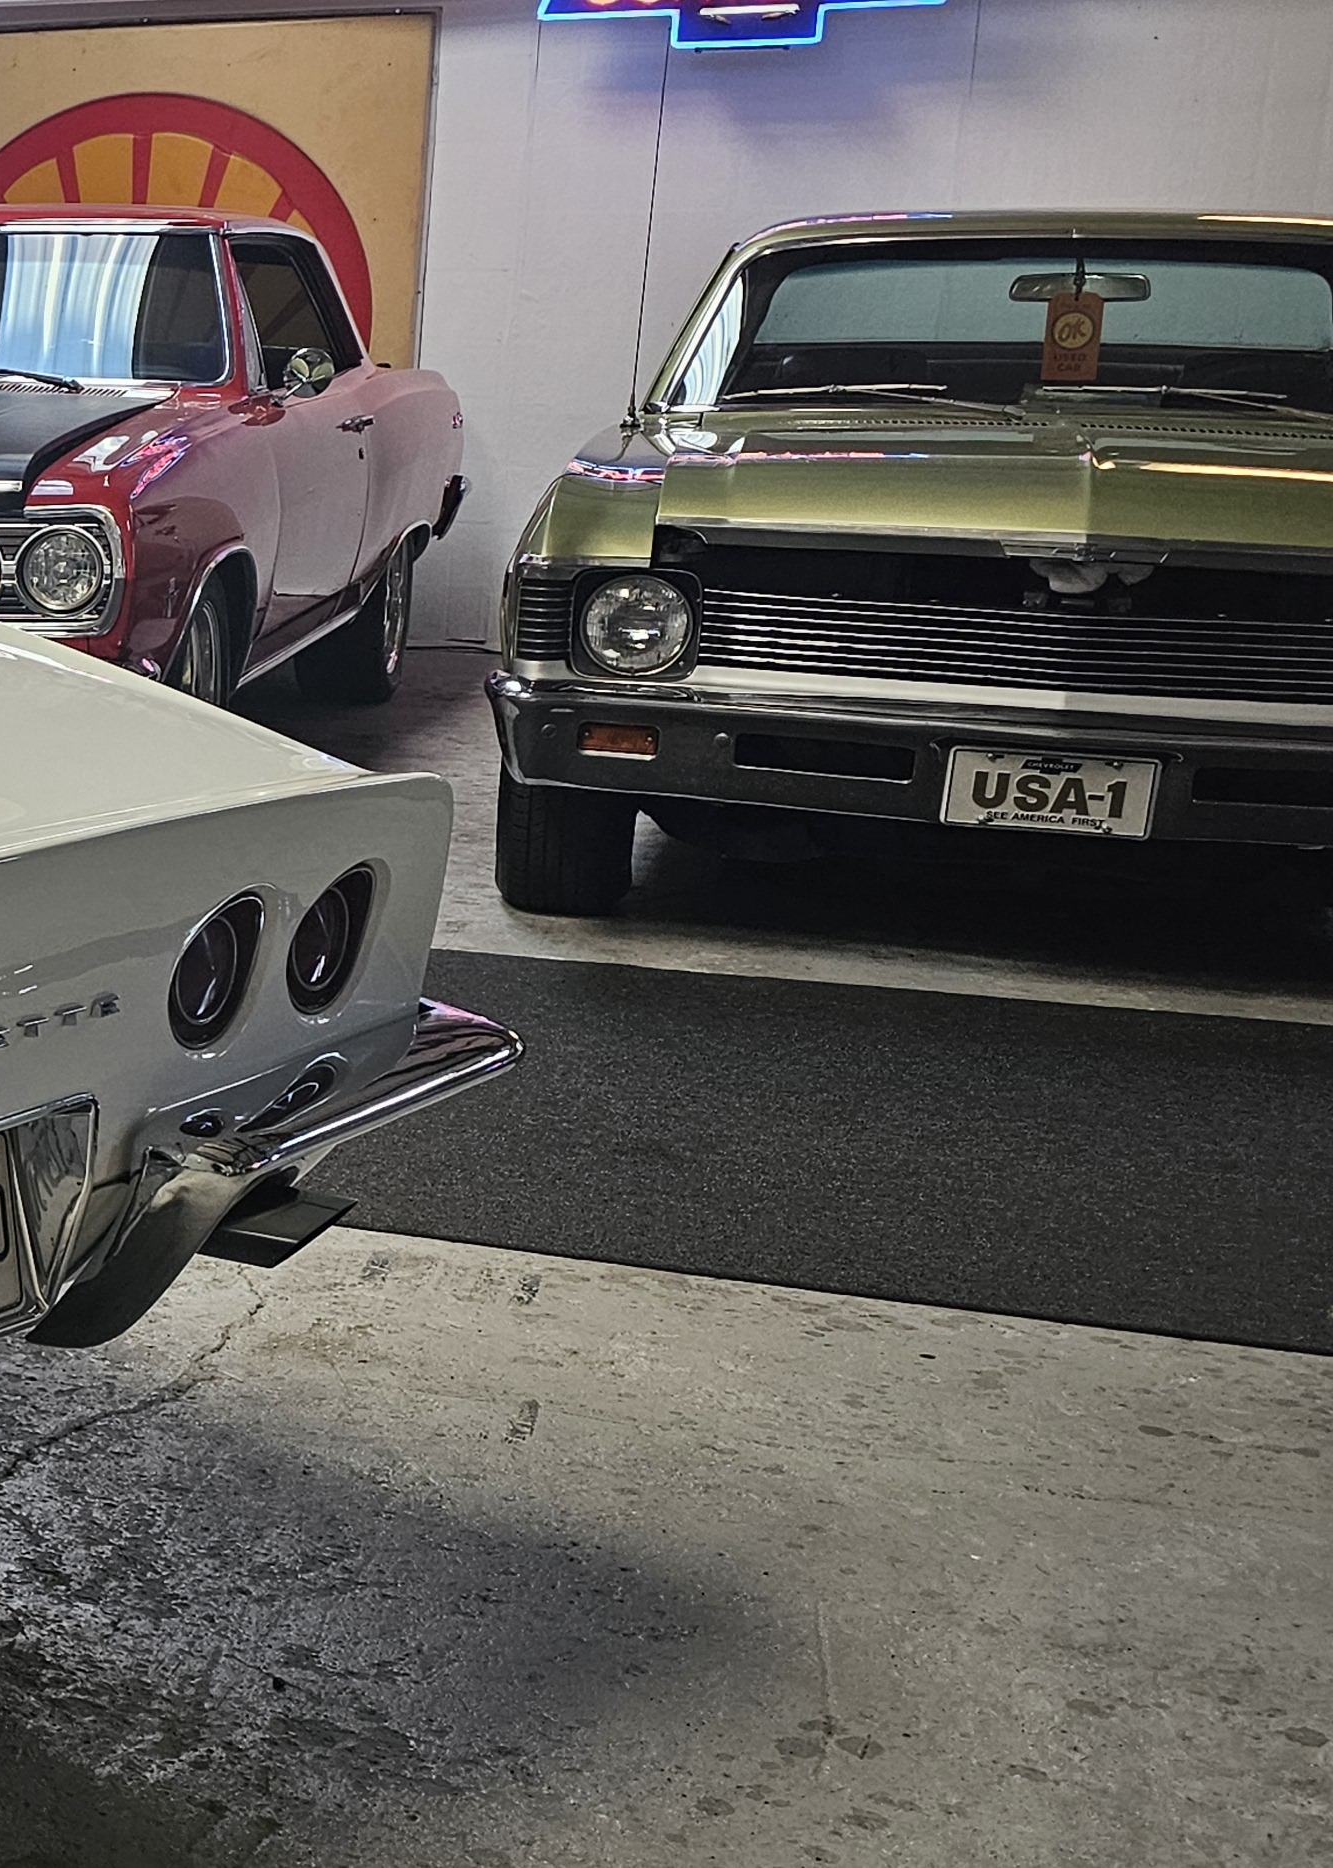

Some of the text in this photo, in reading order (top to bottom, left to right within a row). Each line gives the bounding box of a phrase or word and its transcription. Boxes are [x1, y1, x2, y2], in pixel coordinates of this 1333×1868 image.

[1058, 318, 1087, 342] OK
[1026, 761, 1076, 771] CHEVROLET
[972, 770, 1127, 819] USA-1
[986, 810, 1007, 821] SEE
[1011, 813, 1065, 825] AMERICA
